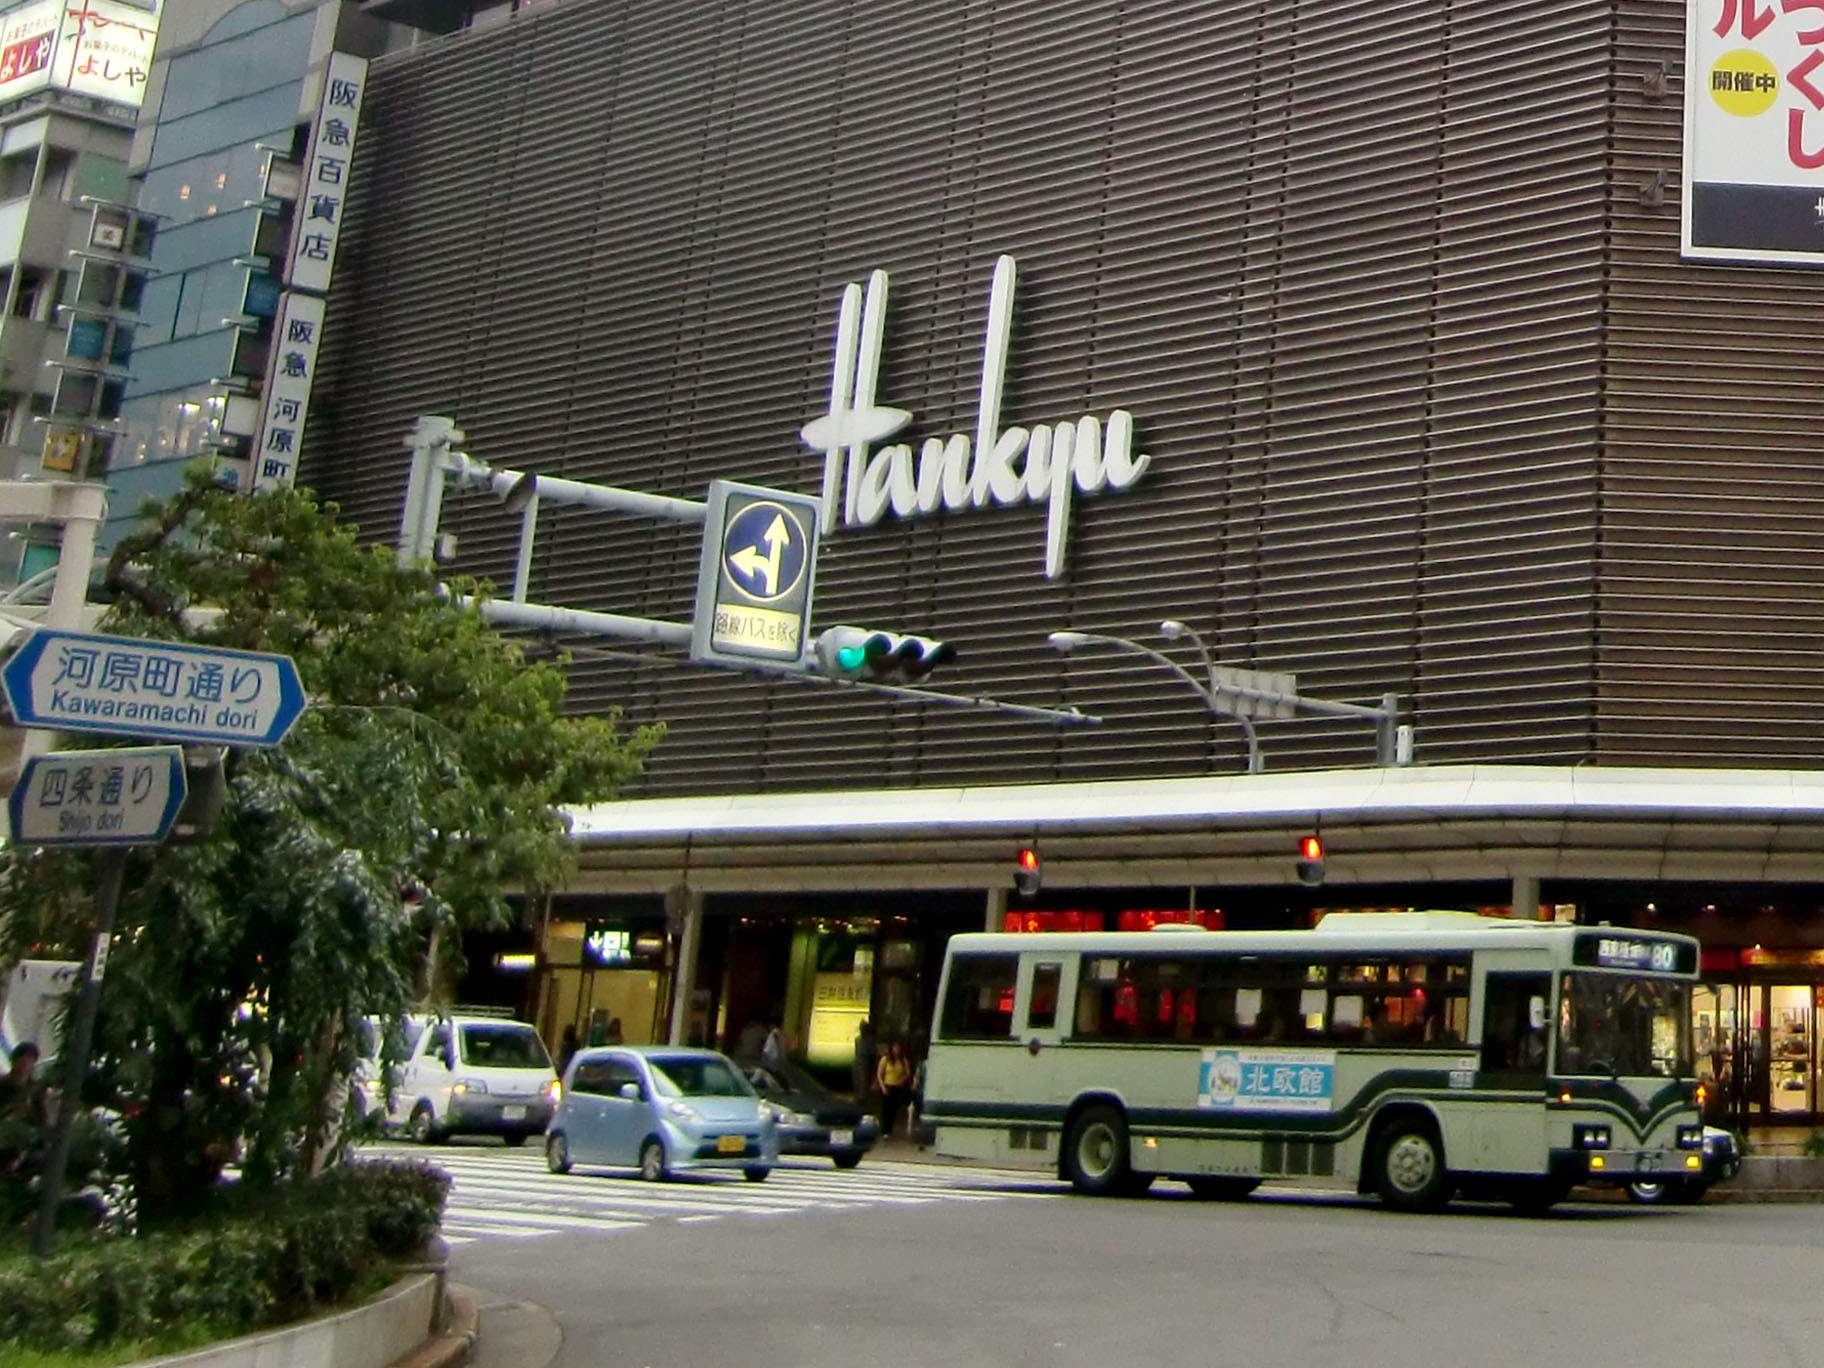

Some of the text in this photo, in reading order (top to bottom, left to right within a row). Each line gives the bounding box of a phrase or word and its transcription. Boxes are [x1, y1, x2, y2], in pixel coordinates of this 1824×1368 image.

[77, 54, 148, 87] よしや
[1712, 70, 1776, 93] 開催中
[300, 78, 360, 262] 阪急百貨店
[280, 318, 315, 378] 阪急
[799, 253, 1151, 579] Hankyu
[52, 646, 262, 705] 河原町通り
[51, 688, 258, 730] Kawaramachi dori
[40, 766, 153, 807] 四条通り
[97, 807, 124, 831] dori
[1245, 1065, 1325, 1095] 北欧館
